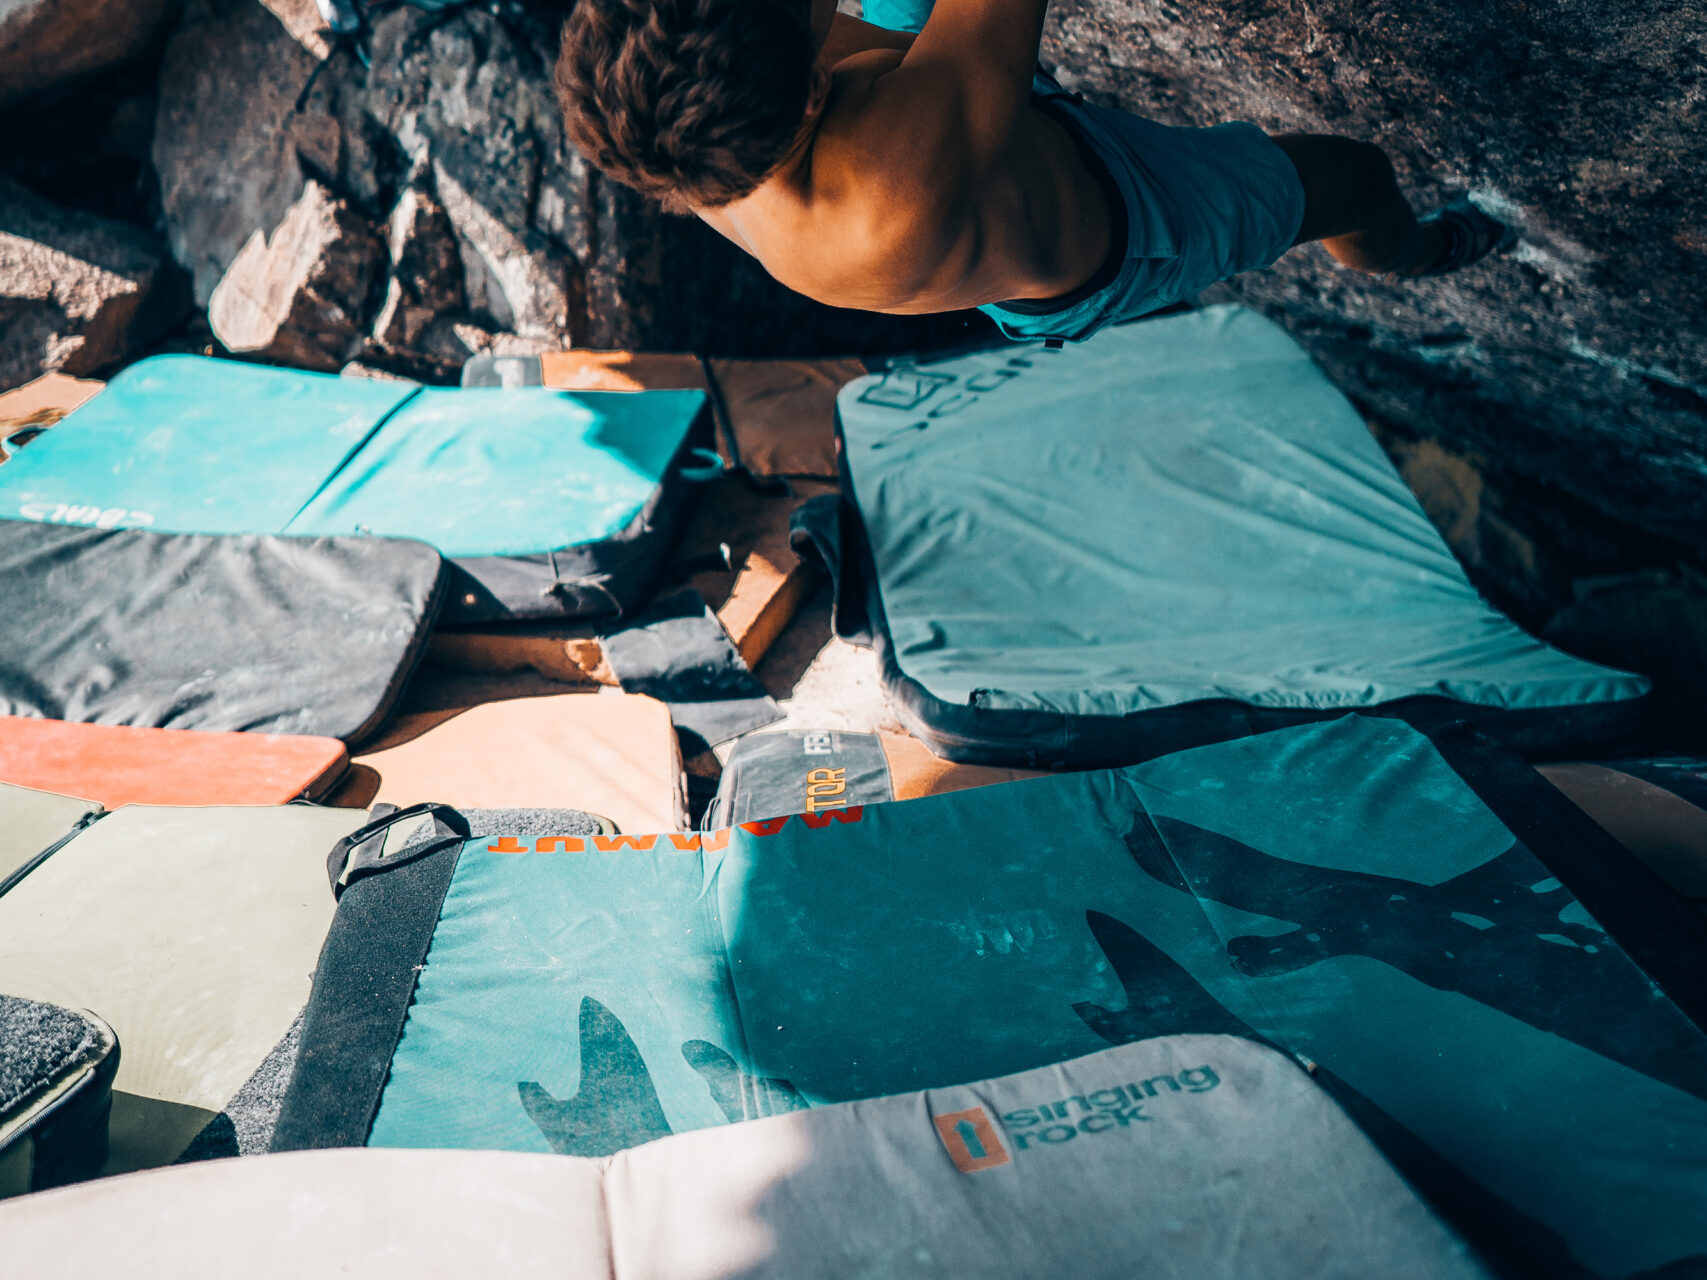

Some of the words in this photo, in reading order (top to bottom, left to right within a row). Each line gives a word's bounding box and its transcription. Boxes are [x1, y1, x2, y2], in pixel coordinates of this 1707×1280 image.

[487, 805, 863, 853] MAMMUT
[1003, 1065, 1221, 1128] singing
[1012, 1105, 1151, 1150] rock
